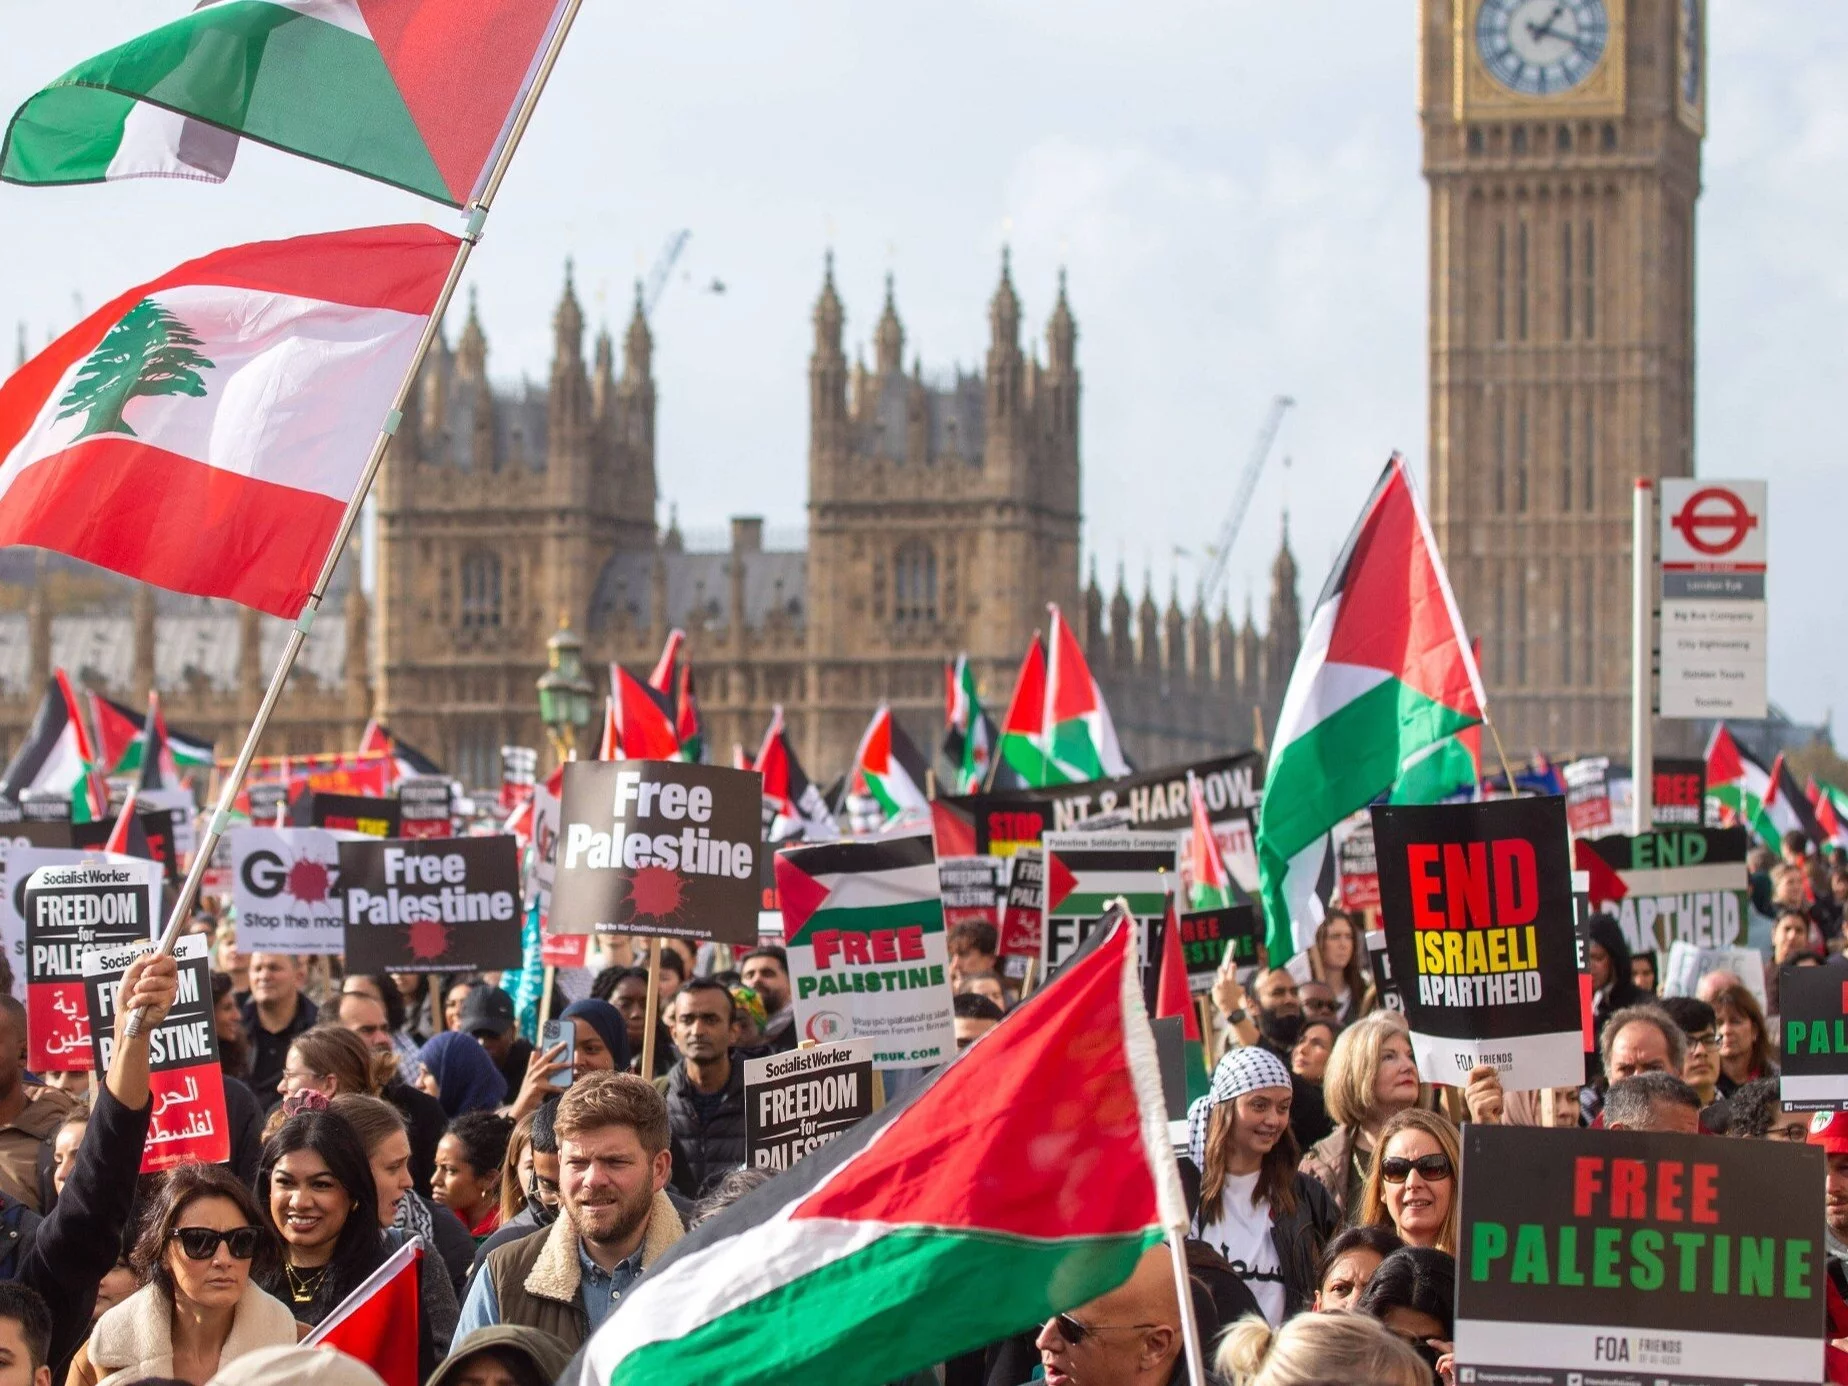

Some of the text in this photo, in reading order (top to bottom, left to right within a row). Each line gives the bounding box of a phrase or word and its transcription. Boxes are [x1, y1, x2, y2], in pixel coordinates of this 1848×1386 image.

[613, 771, 713, 822] Free
[988, 811, 1044, 841] STOP
[1049, 838, 1177, 850] Palestine Solidarity Campaign
[384, 848, 465, 884] Free
[564, 822, 753, 879] Palestine
[1632, 831, 1708, 869] END
[1407, 838, 1539, 930] END
[36, 892, 137, 927] FREEDOM
[244, 914, 280, 930] Stop
[284, 914, 309, 929] the
[348, 886, 513, 925] Palestine
[78, 926, 96, 942] for
[812, 925, 926, 970] FREE
[1180, 918, 1221, 942] REE
[1415, 925, 1538, 975] ISRAELI
[798, 964, 945, 999] PALESTINE
[1418, 970, 1542, 1007] APARTHEID
[1479, 1053, 1513, 1065] FRIENDS
[760, 1072, 858, 1128] FREEDOM
[800, 1118, 817, 1137] for
[1573, 1156, 1720, 1225] FREE
[1471, 1221, 1813, 1299] PALESTINE
[1594, 1336, 1682, 1363] FOA FRIENDS
